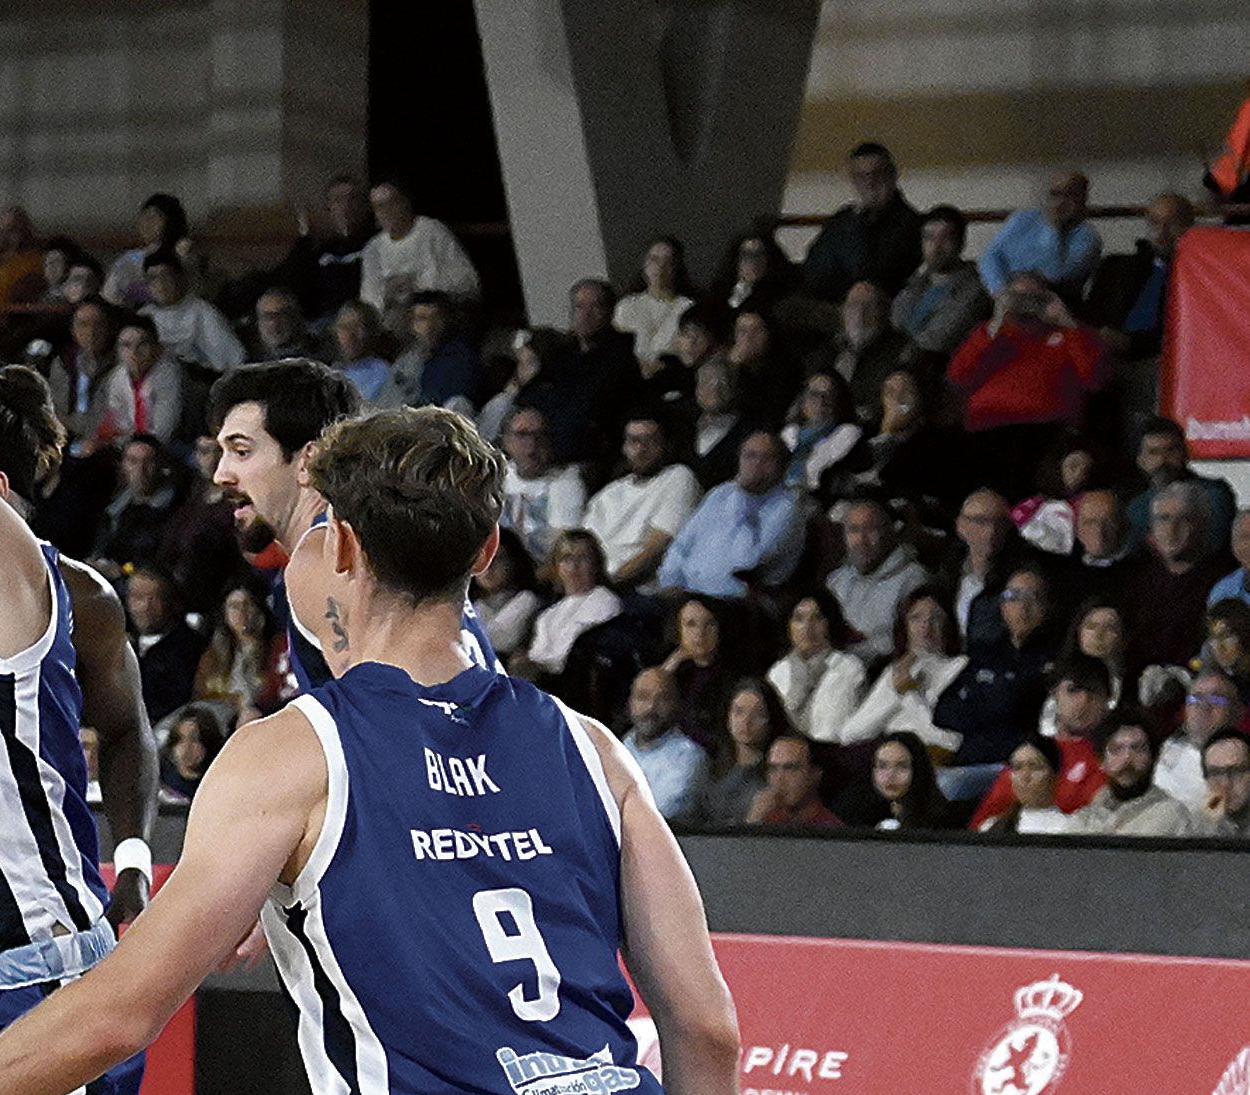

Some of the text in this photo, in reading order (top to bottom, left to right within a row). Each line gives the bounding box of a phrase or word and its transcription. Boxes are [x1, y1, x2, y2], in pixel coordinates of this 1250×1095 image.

[424, 746, 502, 797] BLAK
[410, 828, 553, 862] REDYTEL
[472, 887, 562, 1022] 9
[743, 1044, 849, 1083] PIRE
